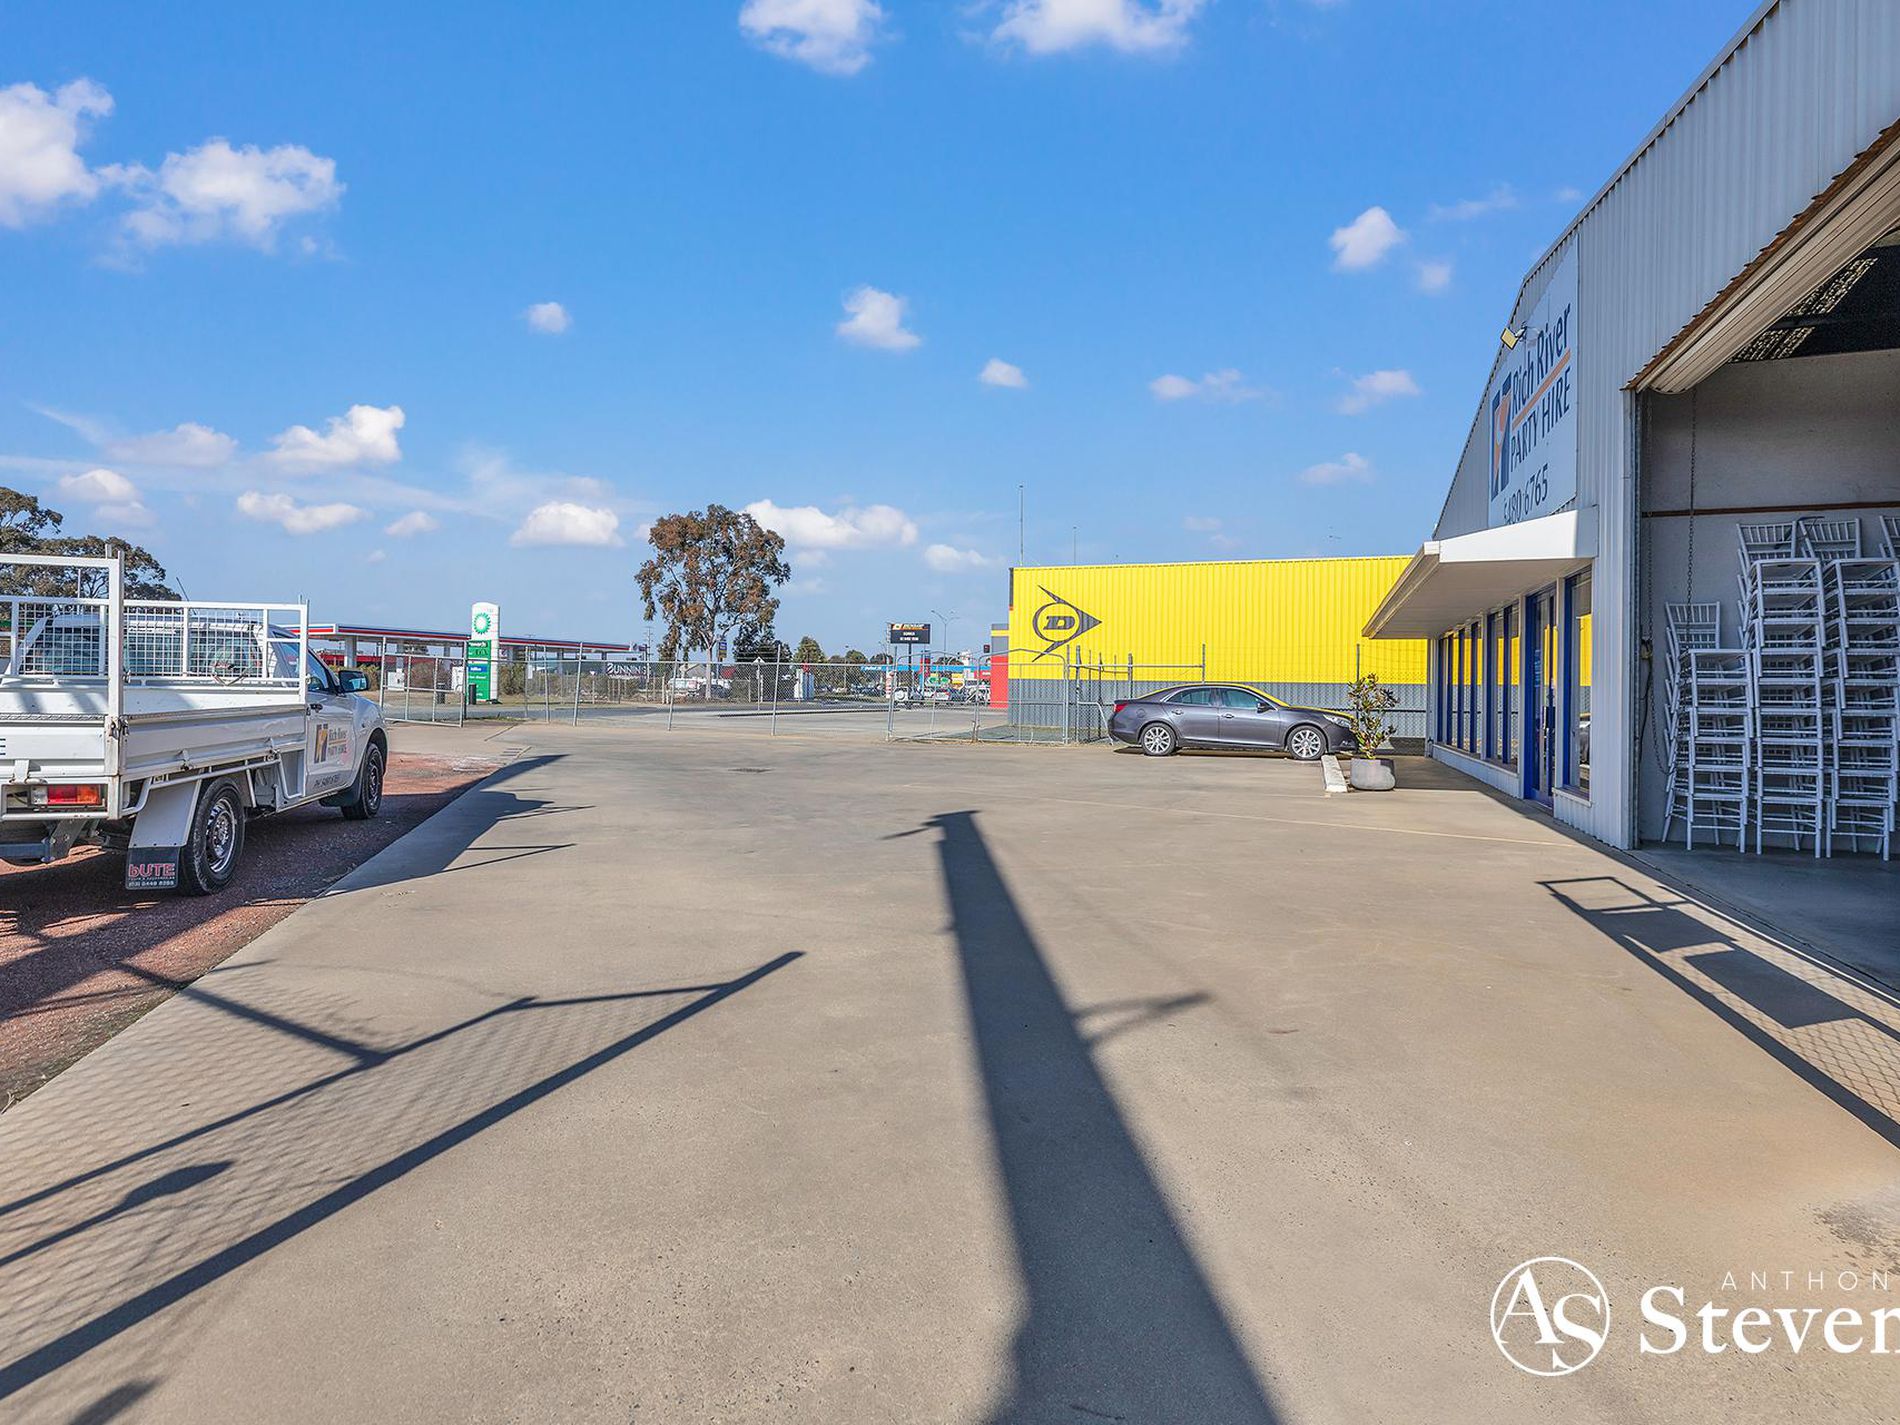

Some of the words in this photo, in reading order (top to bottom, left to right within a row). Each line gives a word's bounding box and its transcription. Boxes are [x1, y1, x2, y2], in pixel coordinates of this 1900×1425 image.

[1512, 350, 1533, 420] Rich
[1537, 303, 1571, 386] River
[1510, 406, 1540, 473] PARTY
[1542, 366, 1571, 439] HIRE
[1525, 463, 1548, 515] 6765
